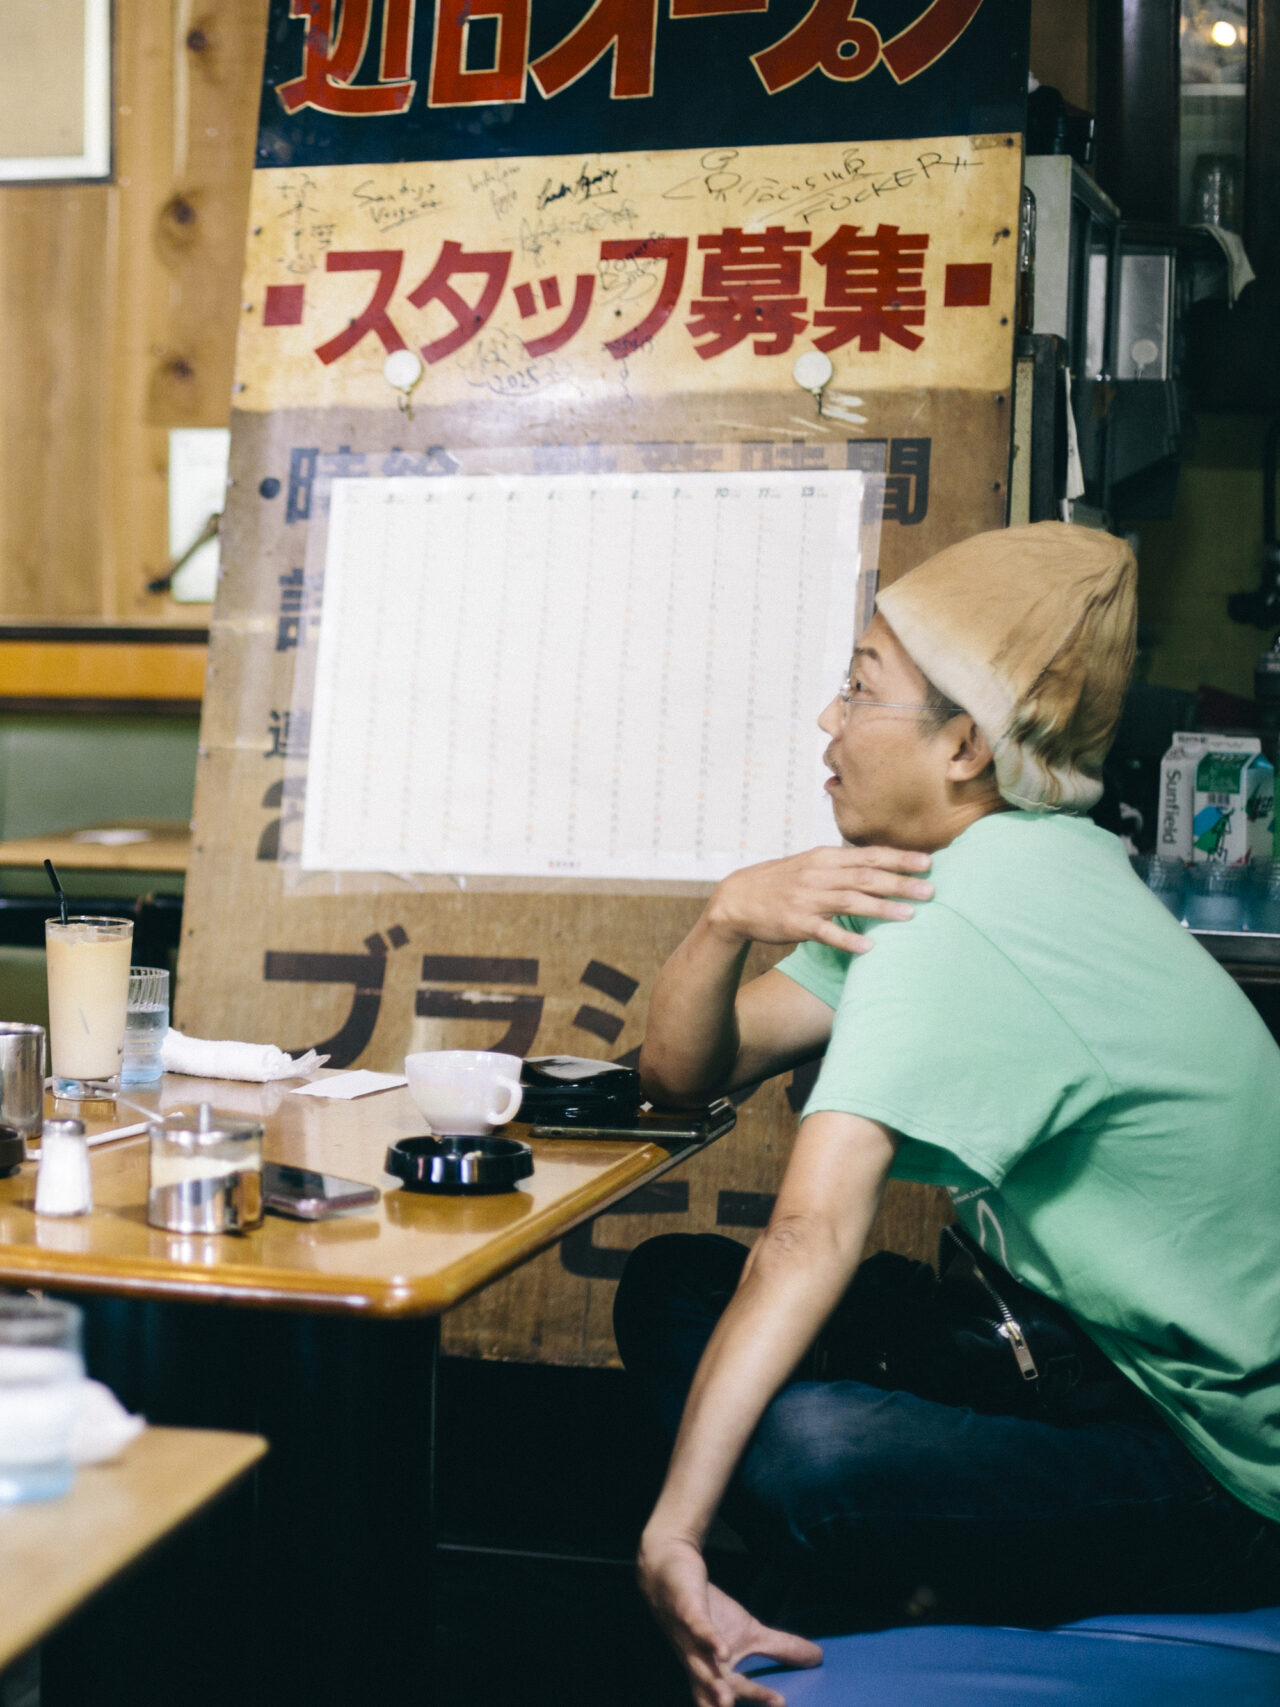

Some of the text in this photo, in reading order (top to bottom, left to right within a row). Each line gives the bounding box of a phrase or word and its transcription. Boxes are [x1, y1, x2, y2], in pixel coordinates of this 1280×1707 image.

[315, 223, 931, 366] スタッフ募集
